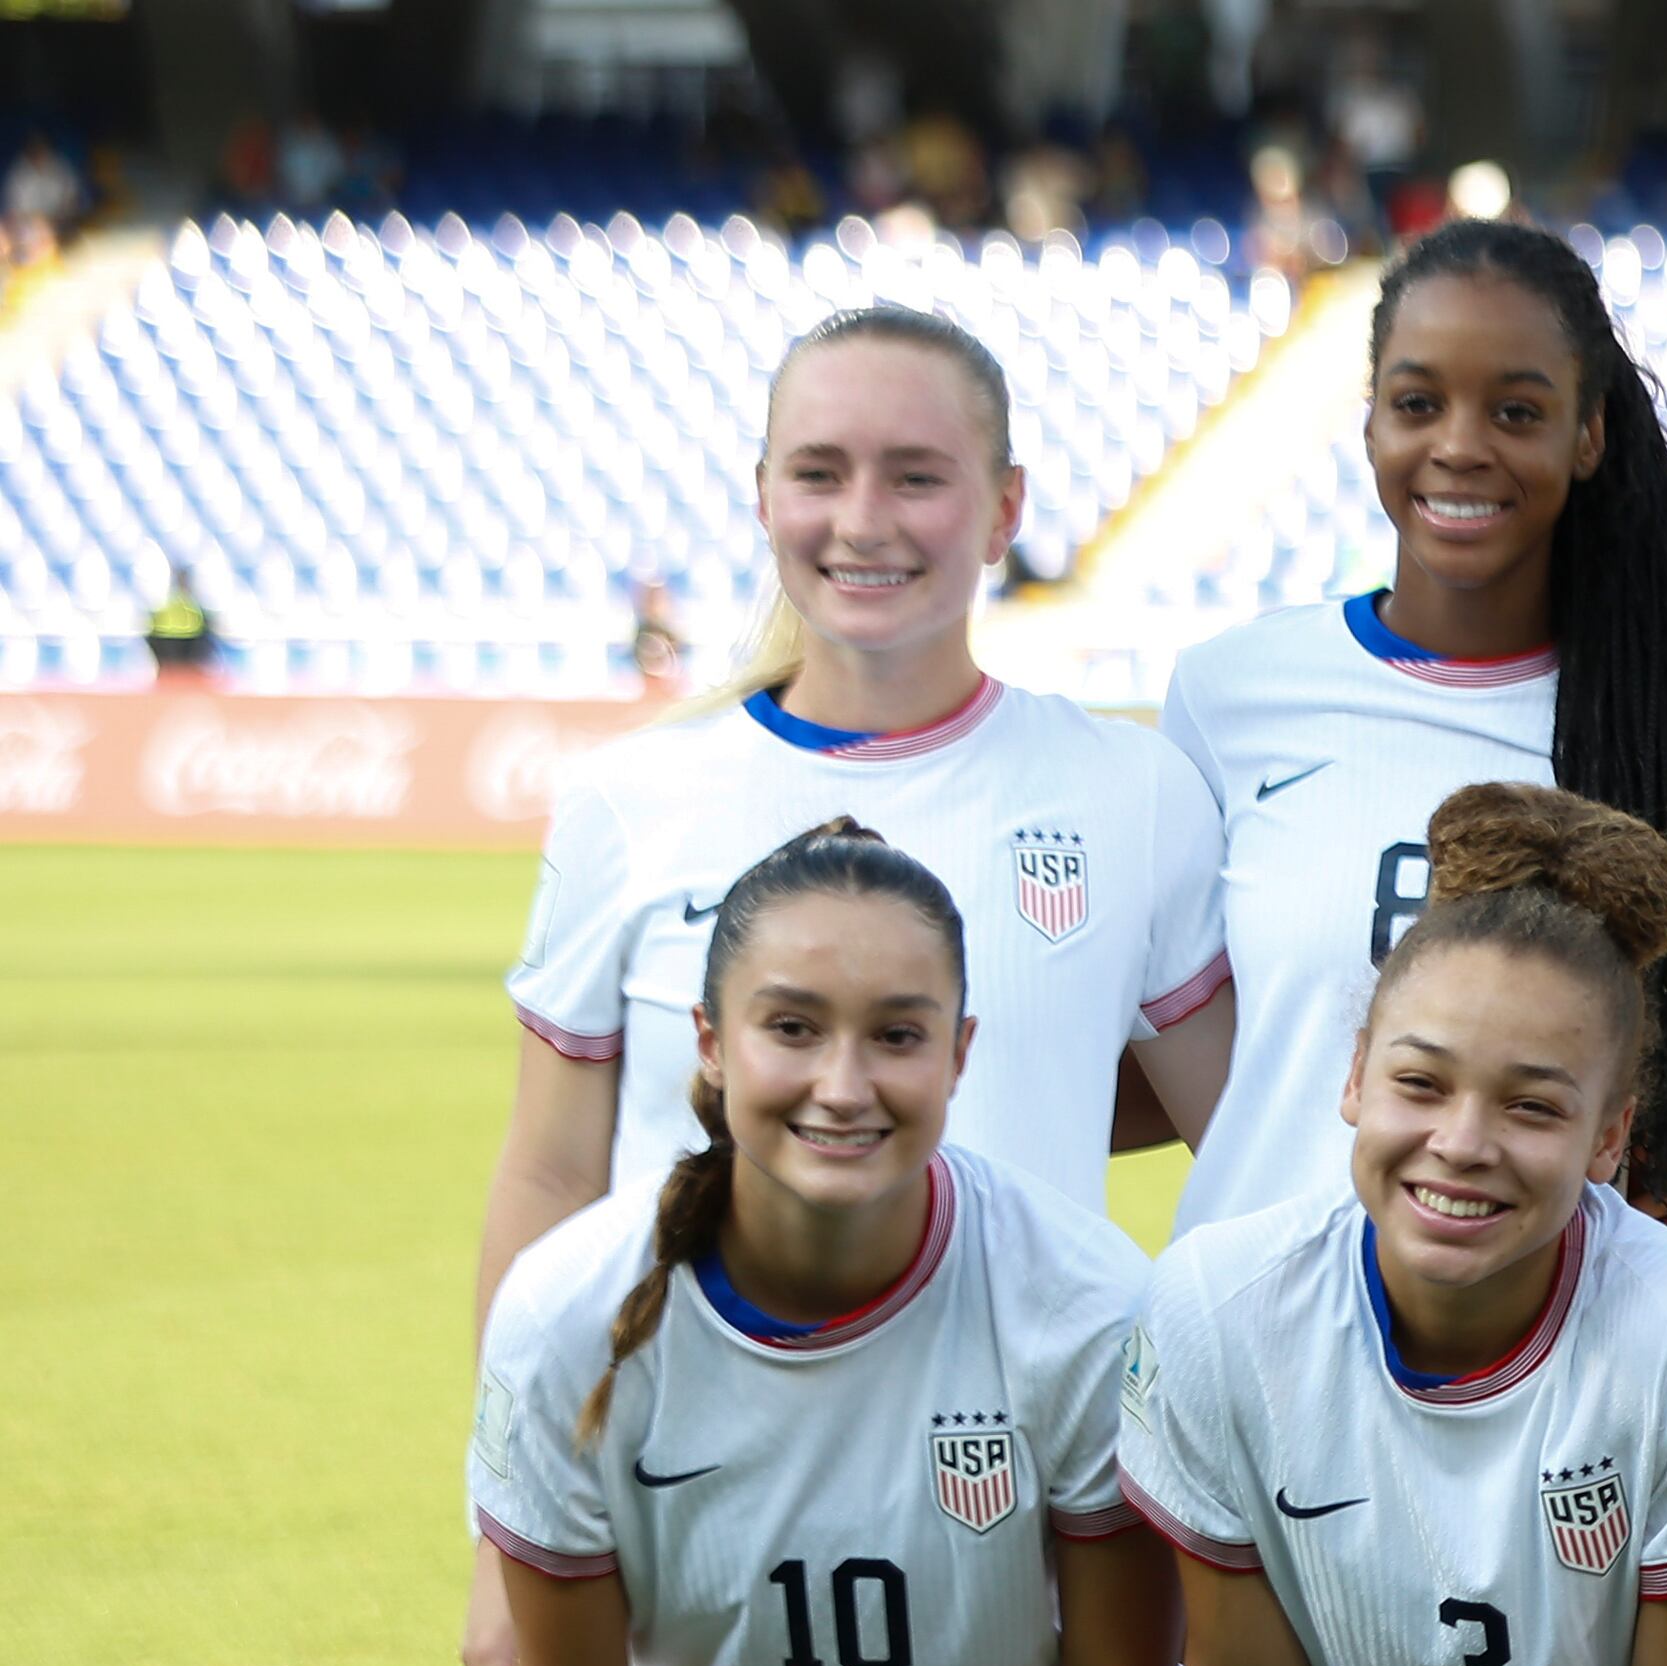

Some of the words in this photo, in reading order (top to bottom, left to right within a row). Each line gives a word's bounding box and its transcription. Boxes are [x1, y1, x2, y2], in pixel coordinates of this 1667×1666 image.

[1021, 853, 1082, 887] USA
[938, 1438, 1006, 1477] USA
[1549, 1480, 1619, 1527] USA
